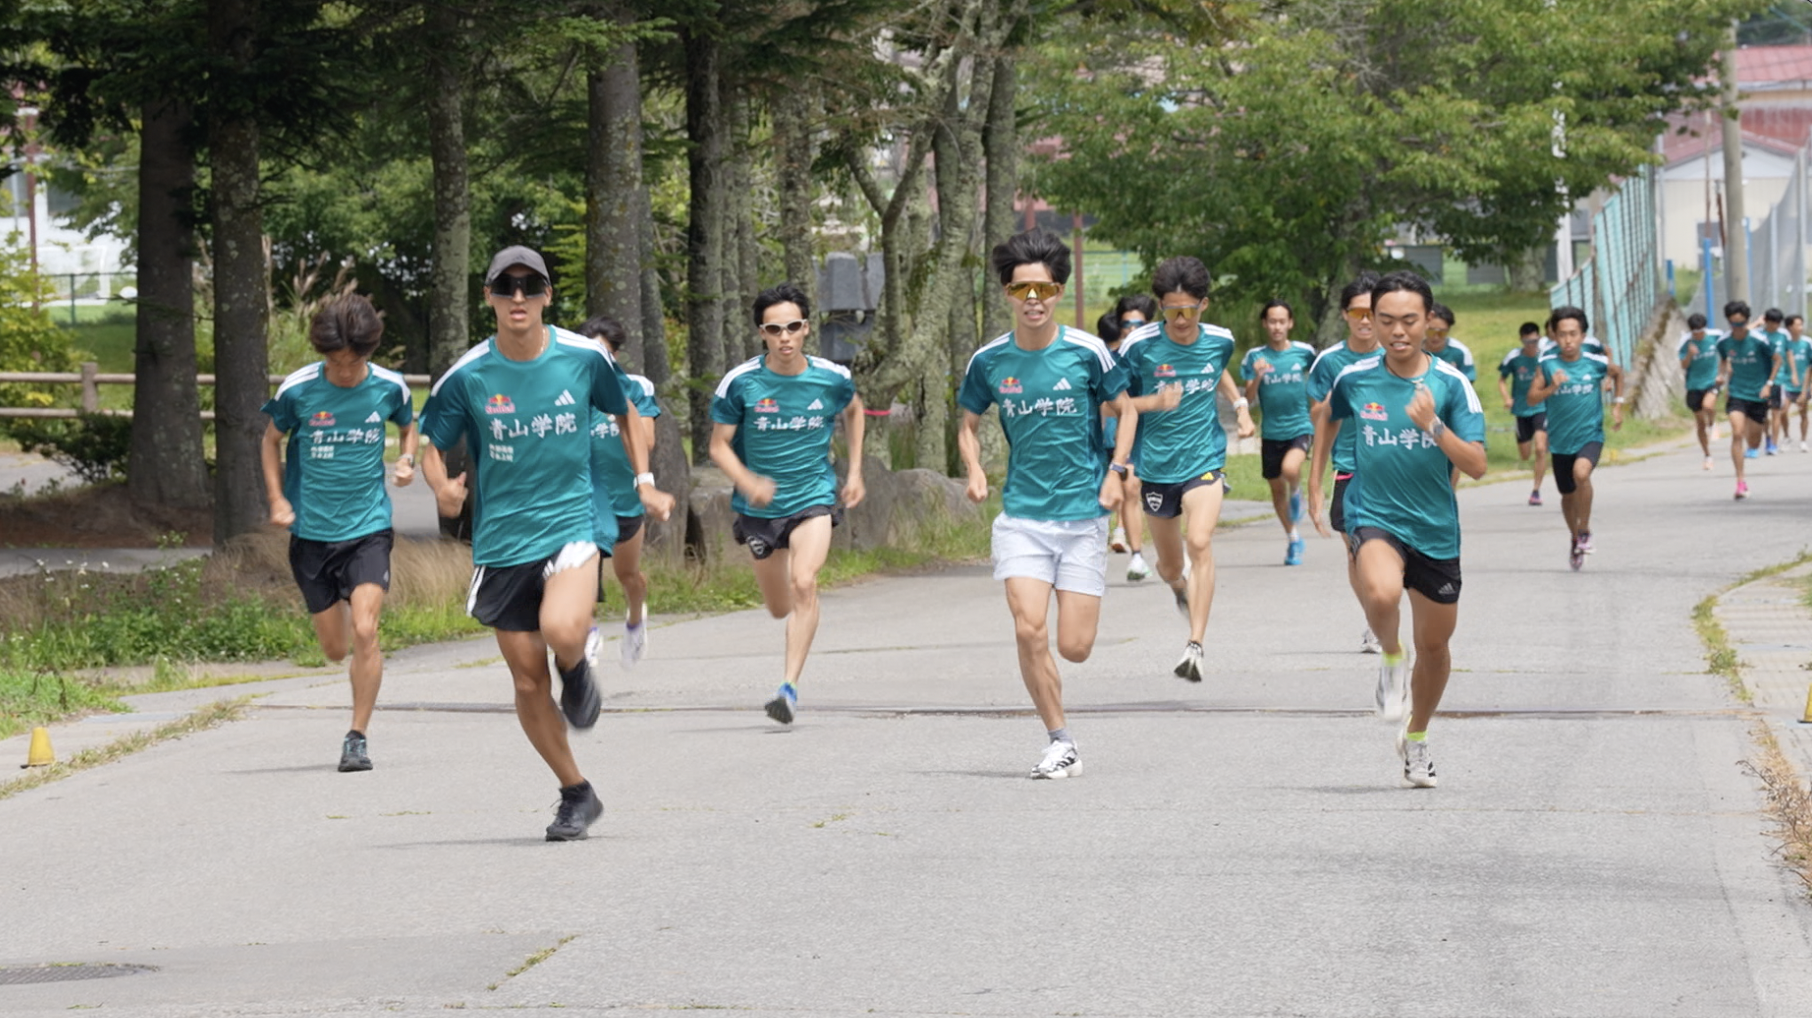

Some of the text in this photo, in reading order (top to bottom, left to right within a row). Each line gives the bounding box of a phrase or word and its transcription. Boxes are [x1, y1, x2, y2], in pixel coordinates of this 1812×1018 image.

[1154, 378, 1215, 395] 青学院
[1001, 397, 1077, 418] 青山学院
[488, 412, 578, 441] 青山学院
[753, 415, 825, 431] 青山学院
